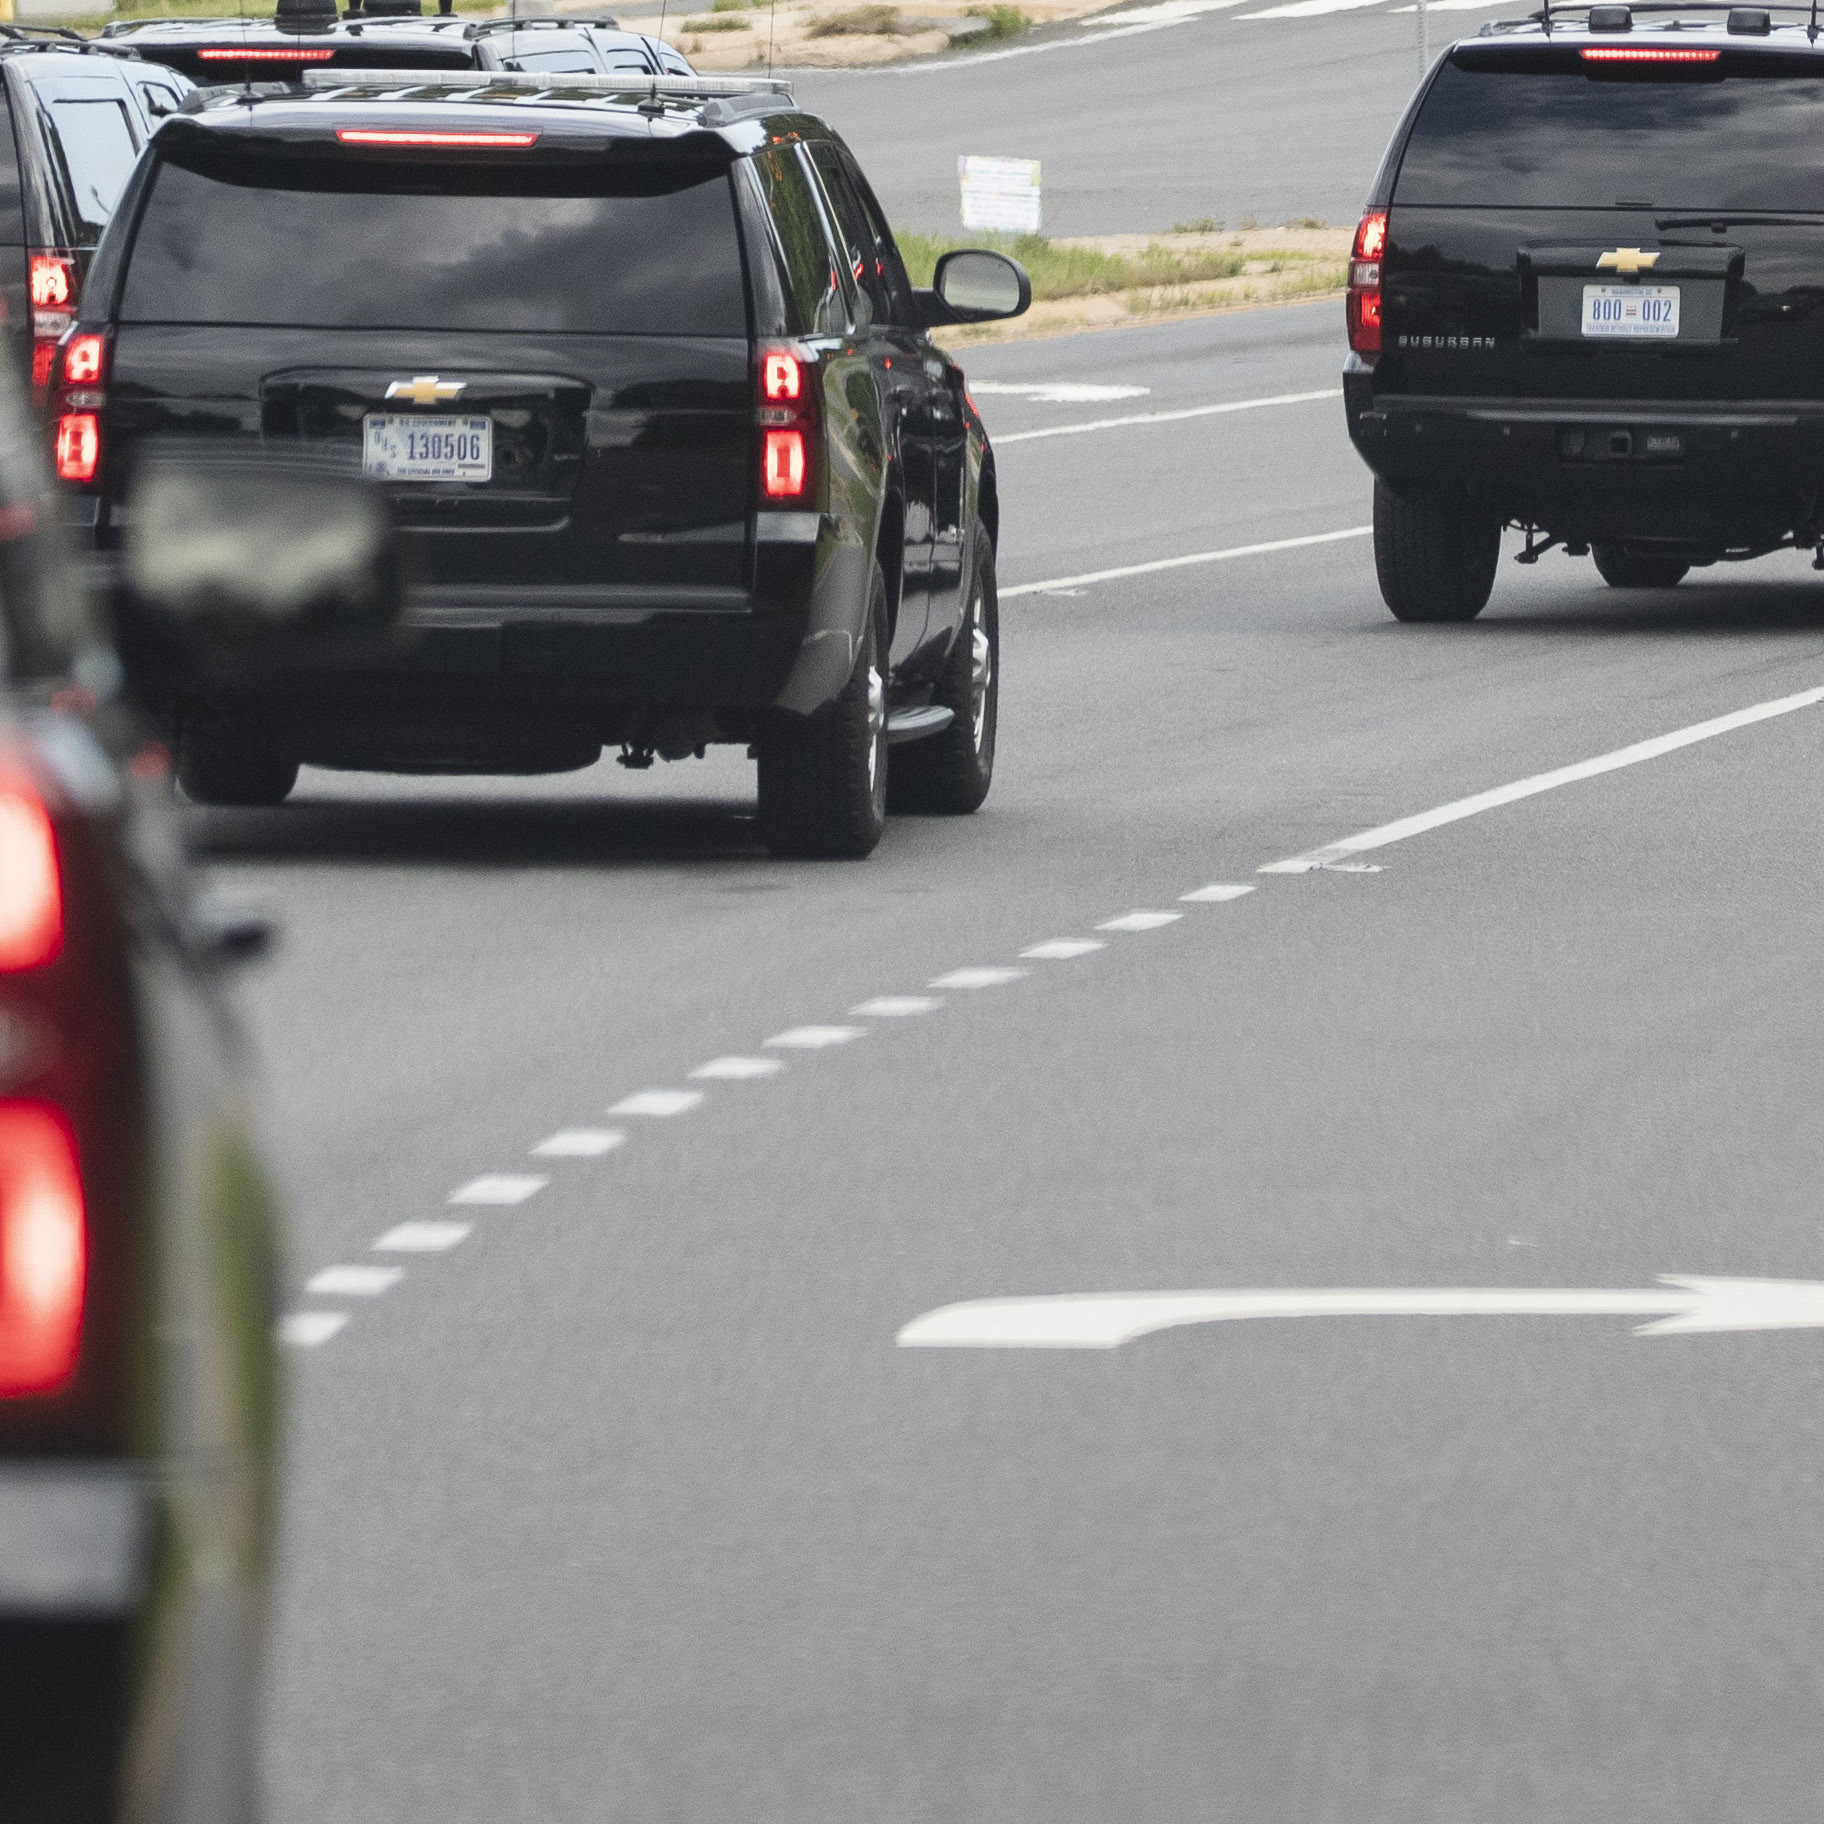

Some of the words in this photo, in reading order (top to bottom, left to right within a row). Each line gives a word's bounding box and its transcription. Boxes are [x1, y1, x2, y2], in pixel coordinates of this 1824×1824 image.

[1592, 298, 1622, 321] 800
[1642, 299, 1672, 322] 002
[1399, 336, 1495, 349] SUBURBAN
[408, 432, 480, 461] 130506
